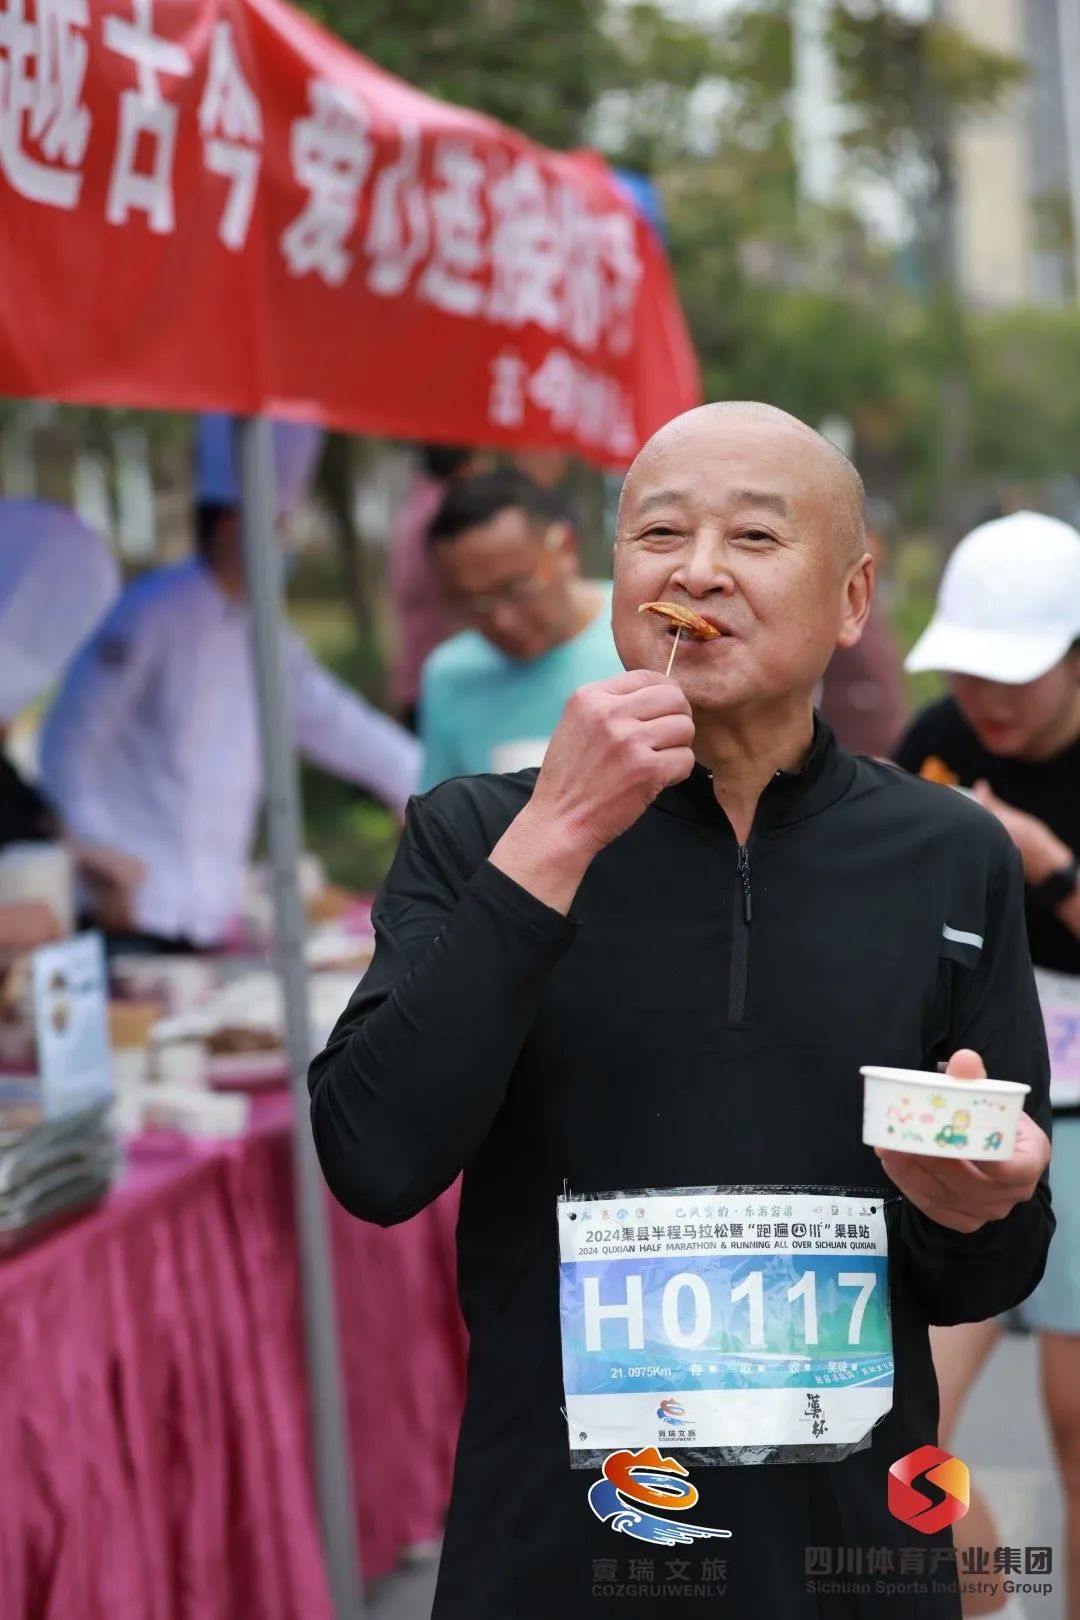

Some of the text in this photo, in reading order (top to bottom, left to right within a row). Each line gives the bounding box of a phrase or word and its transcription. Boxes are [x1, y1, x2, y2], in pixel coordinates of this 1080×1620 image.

[579, 1240, 877, 1256] 2024 QUXIAN HALF MARATHON & RUNNING ALL OVER SICHUAN QUXIAN
[583, 1271, 877, 1352] H0117
[611, 1366, 672, 1379] 21.0975Km
[690, 1363, 704, 1376] 存
